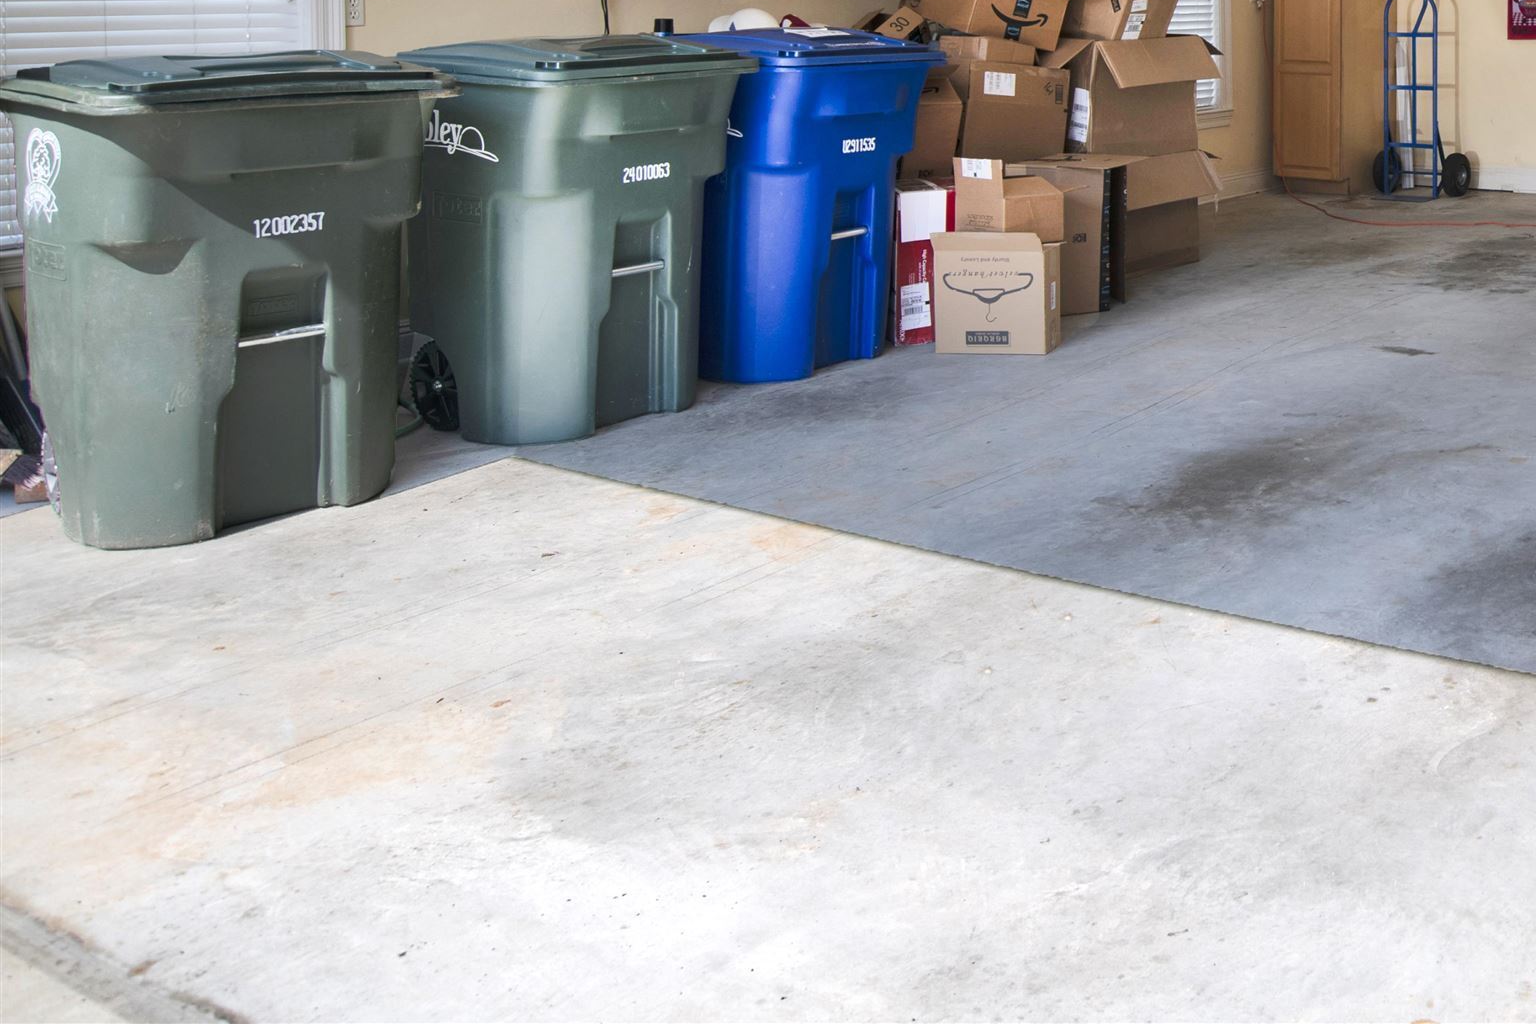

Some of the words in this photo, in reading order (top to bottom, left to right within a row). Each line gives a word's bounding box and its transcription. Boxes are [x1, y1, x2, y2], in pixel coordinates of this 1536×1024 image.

[889, 16, 910, 32] 30
[622, 162, 671, 183] 24010063
[252, 211, 326, 239] 12002357
